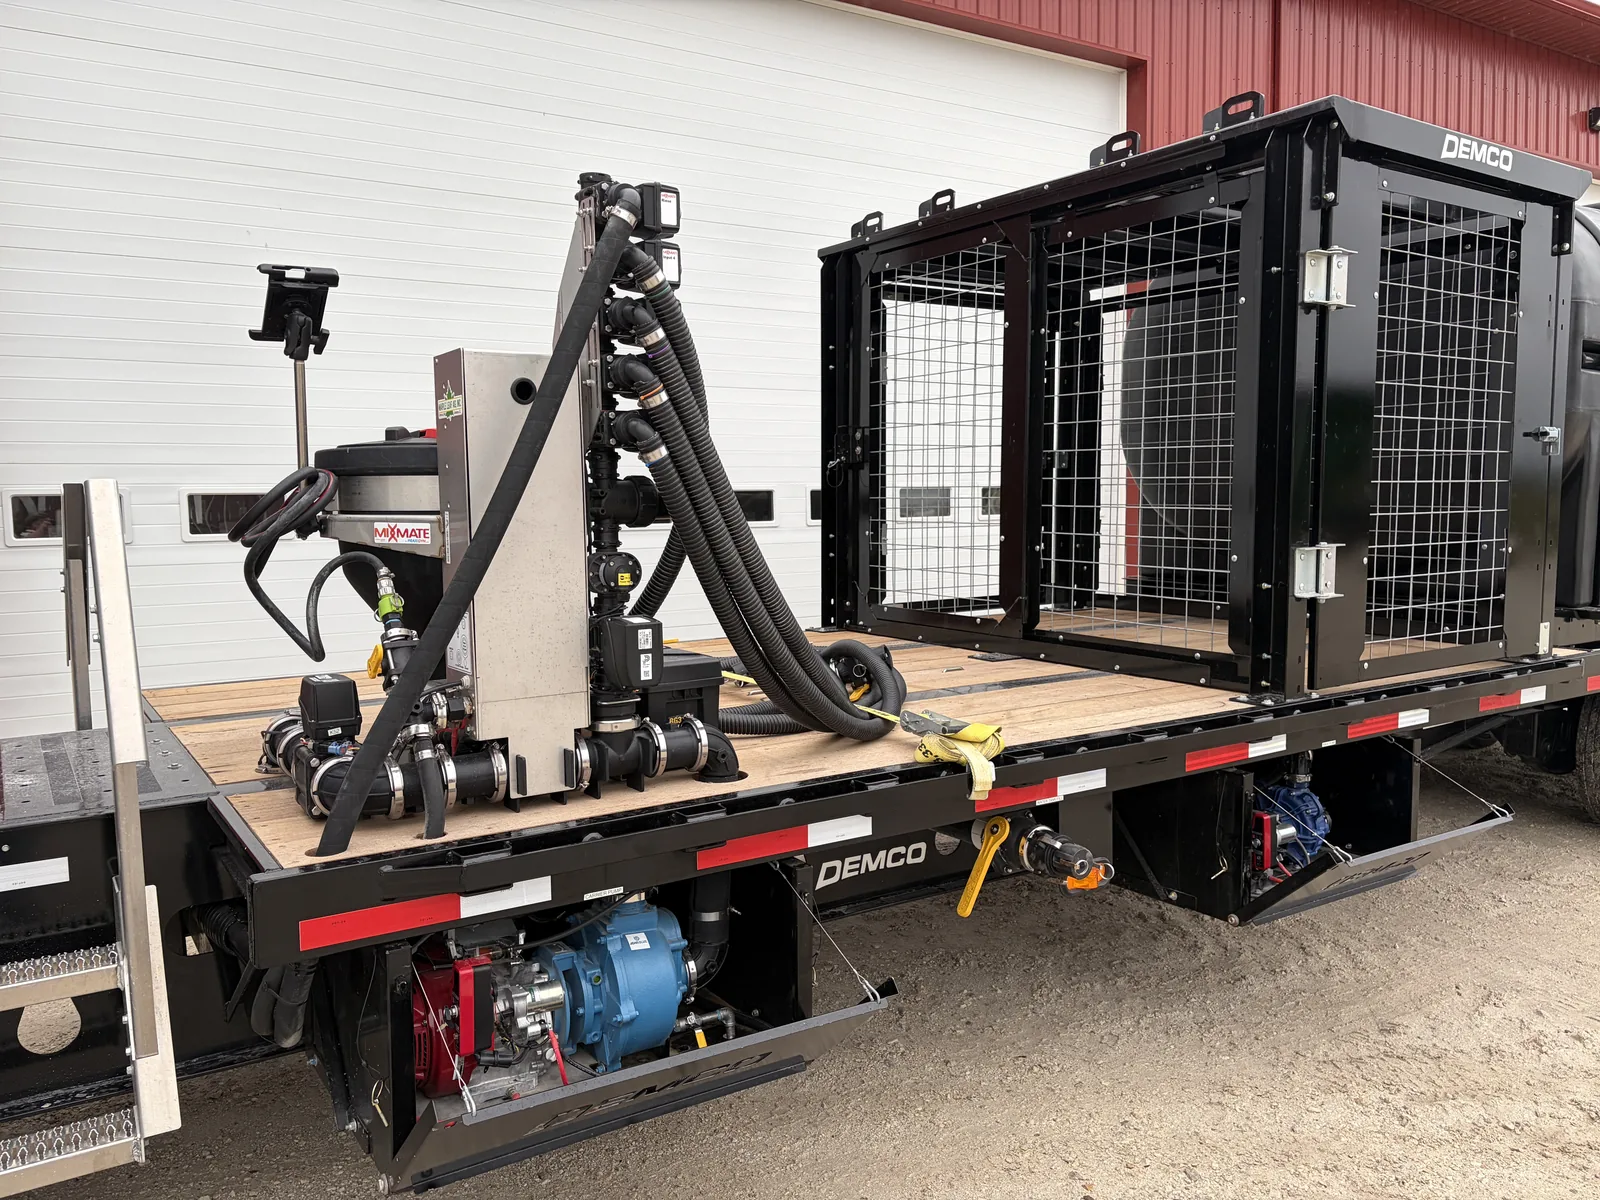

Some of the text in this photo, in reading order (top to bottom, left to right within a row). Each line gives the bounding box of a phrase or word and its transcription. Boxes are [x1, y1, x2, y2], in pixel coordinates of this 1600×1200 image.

[1440, 133, 1513, 172] DEMCO
[374, 523, 429, 542] MIXMATE
[815, 842, 927, 891] DEMCO
[585, 887, 622, 900] CARRIER PUMP
